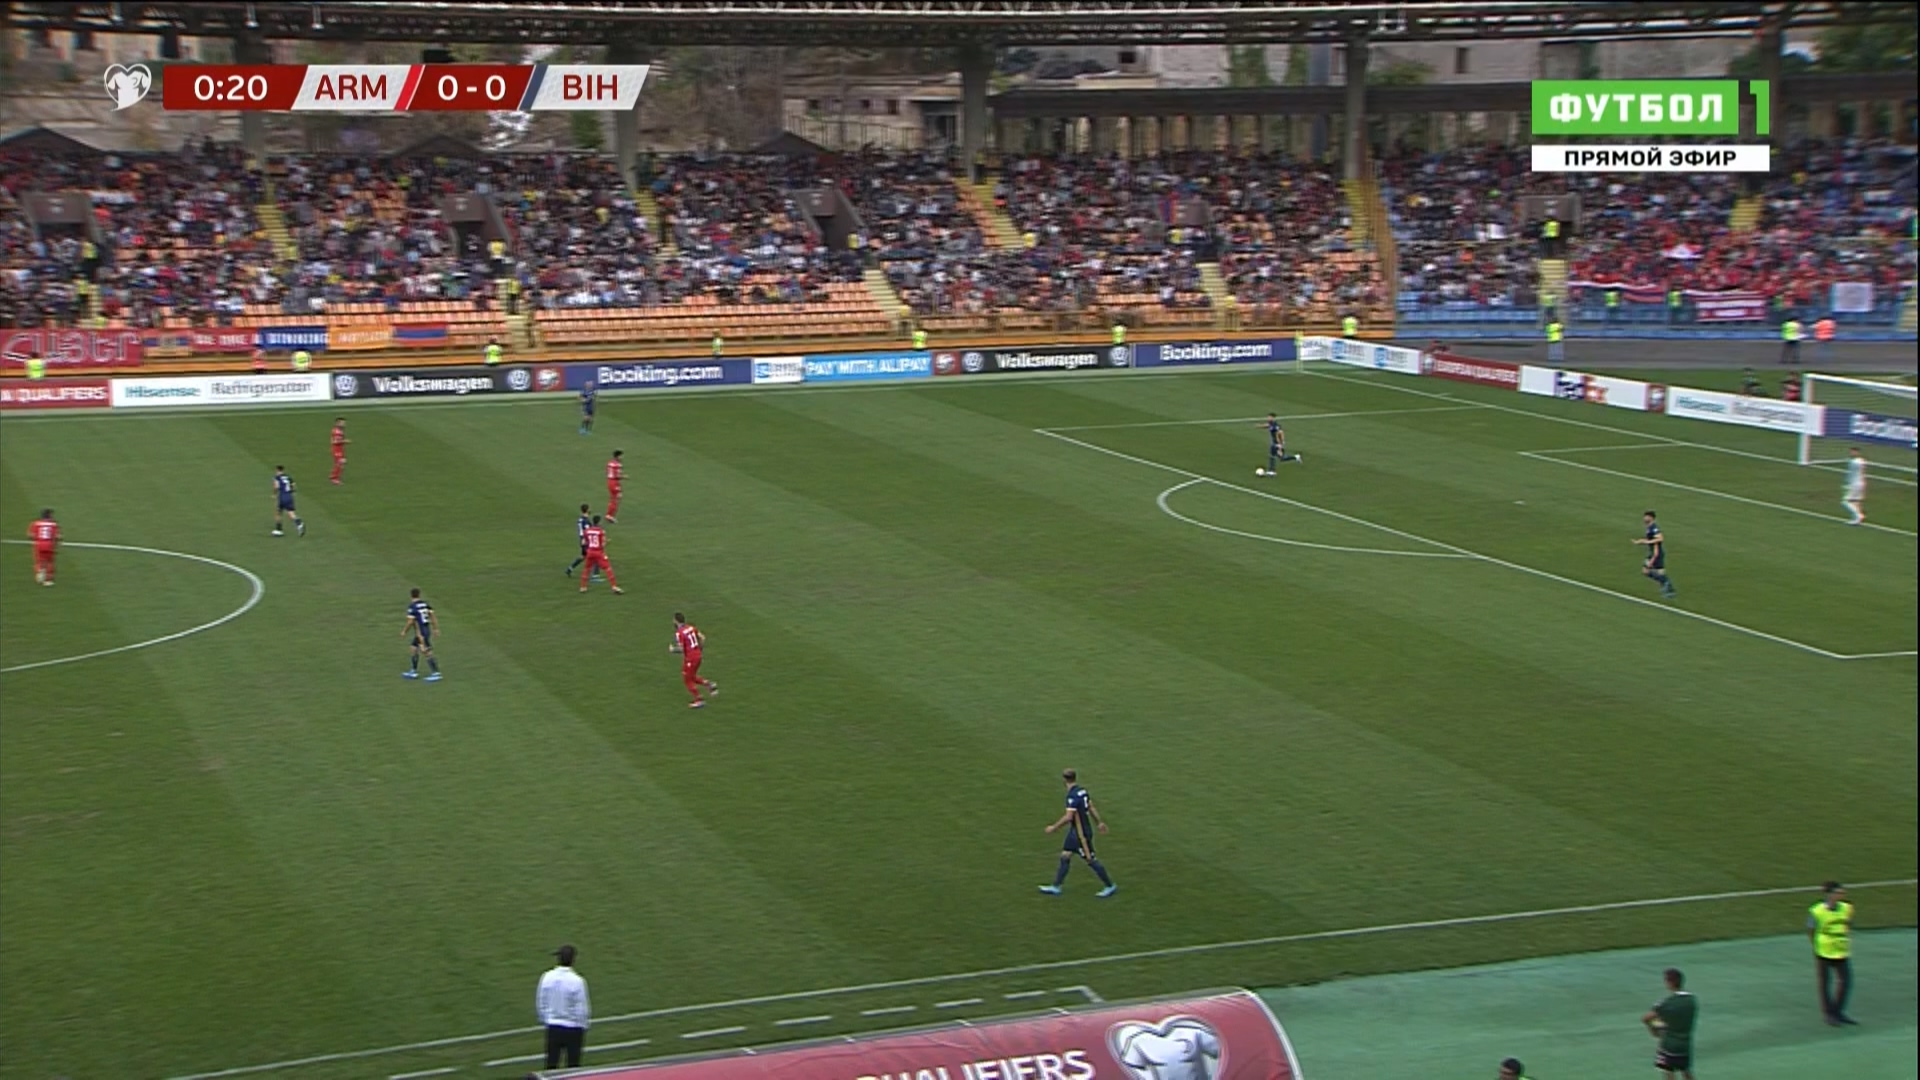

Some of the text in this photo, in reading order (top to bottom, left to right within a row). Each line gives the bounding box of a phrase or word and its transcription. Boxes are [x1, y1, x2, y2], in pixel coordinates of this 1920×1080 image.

[995, 352, 1098, 370] Volkswagen
[1160, 342, 1272, 362] Booking.com
[597, 365, 723, 385] Booking.com
[806, 361, 834, 376] PAY
[837, 359, 875, 375] WITH
[878, 357, 931, 373] ALIPAY
[125, 381, 314, 398] Hisense Refrigerator
[372, 374, 493, 394] Volkswagen
[17, 387, 108, 402] QUALIFIERS
[856, 1050, 1096, 1080] IFIERS
